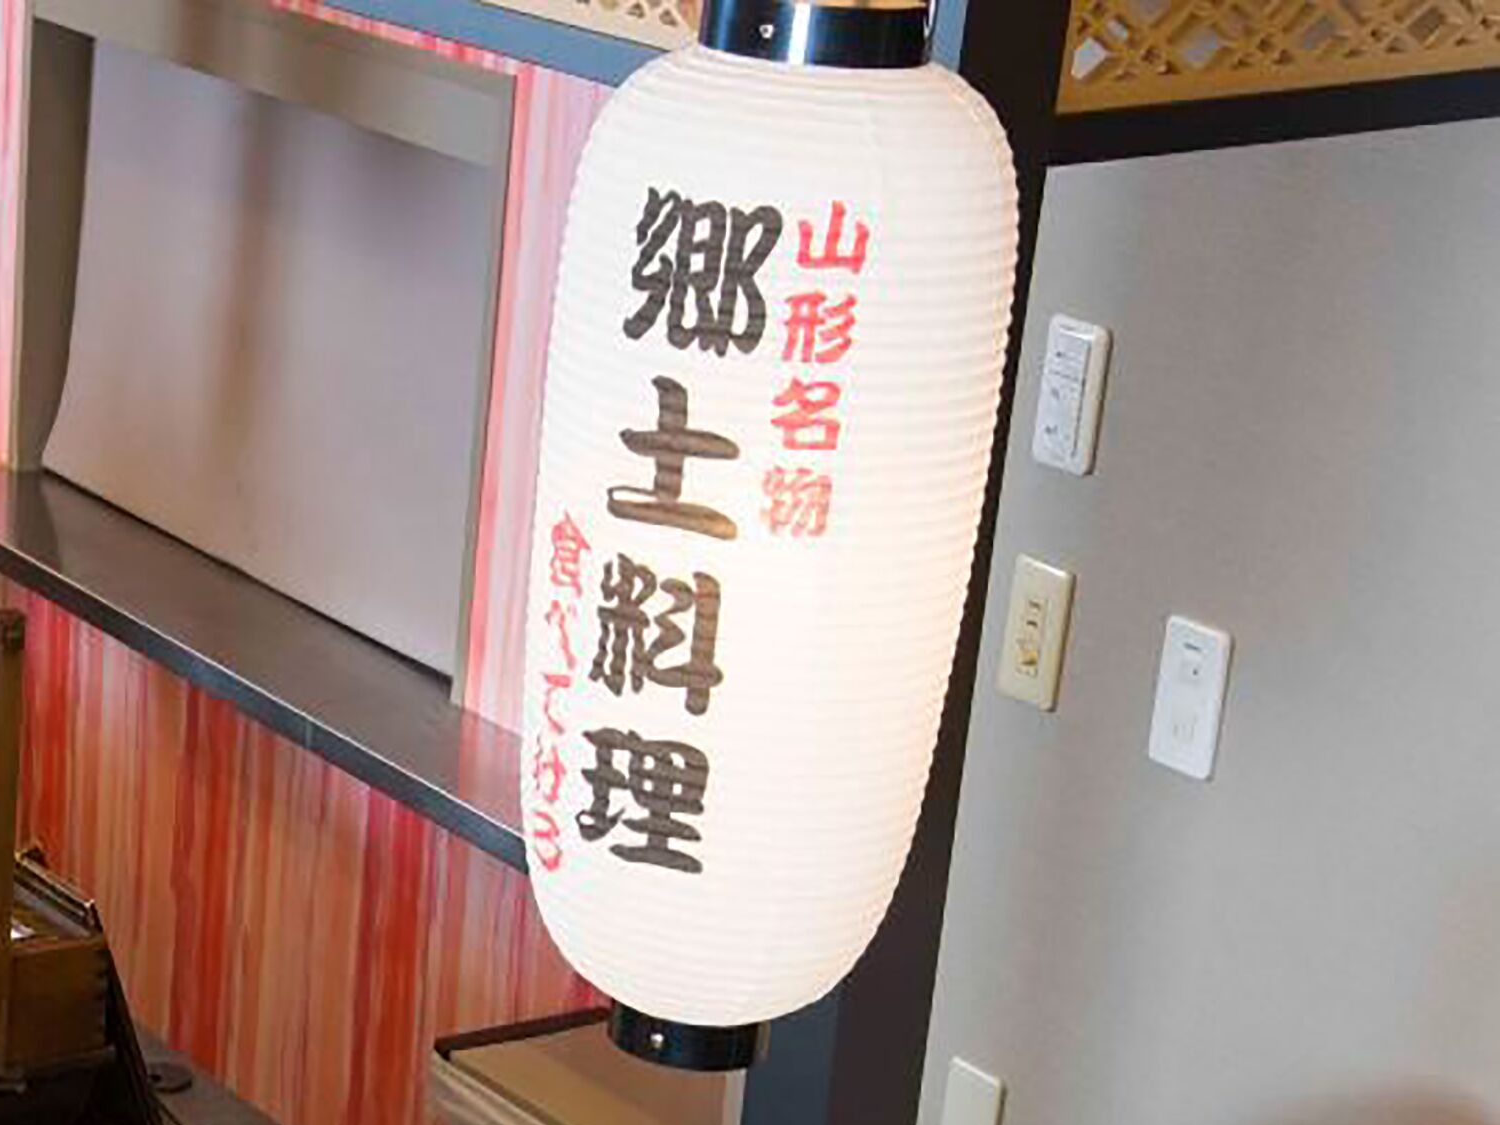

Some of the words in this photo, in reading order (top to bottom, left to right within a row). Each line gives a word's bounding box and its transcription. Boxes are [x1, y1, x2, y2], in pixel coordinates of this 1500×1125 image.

[577, 186, 784, 875] 郷土料理
[763, 201, 869, 537] 山形名物
